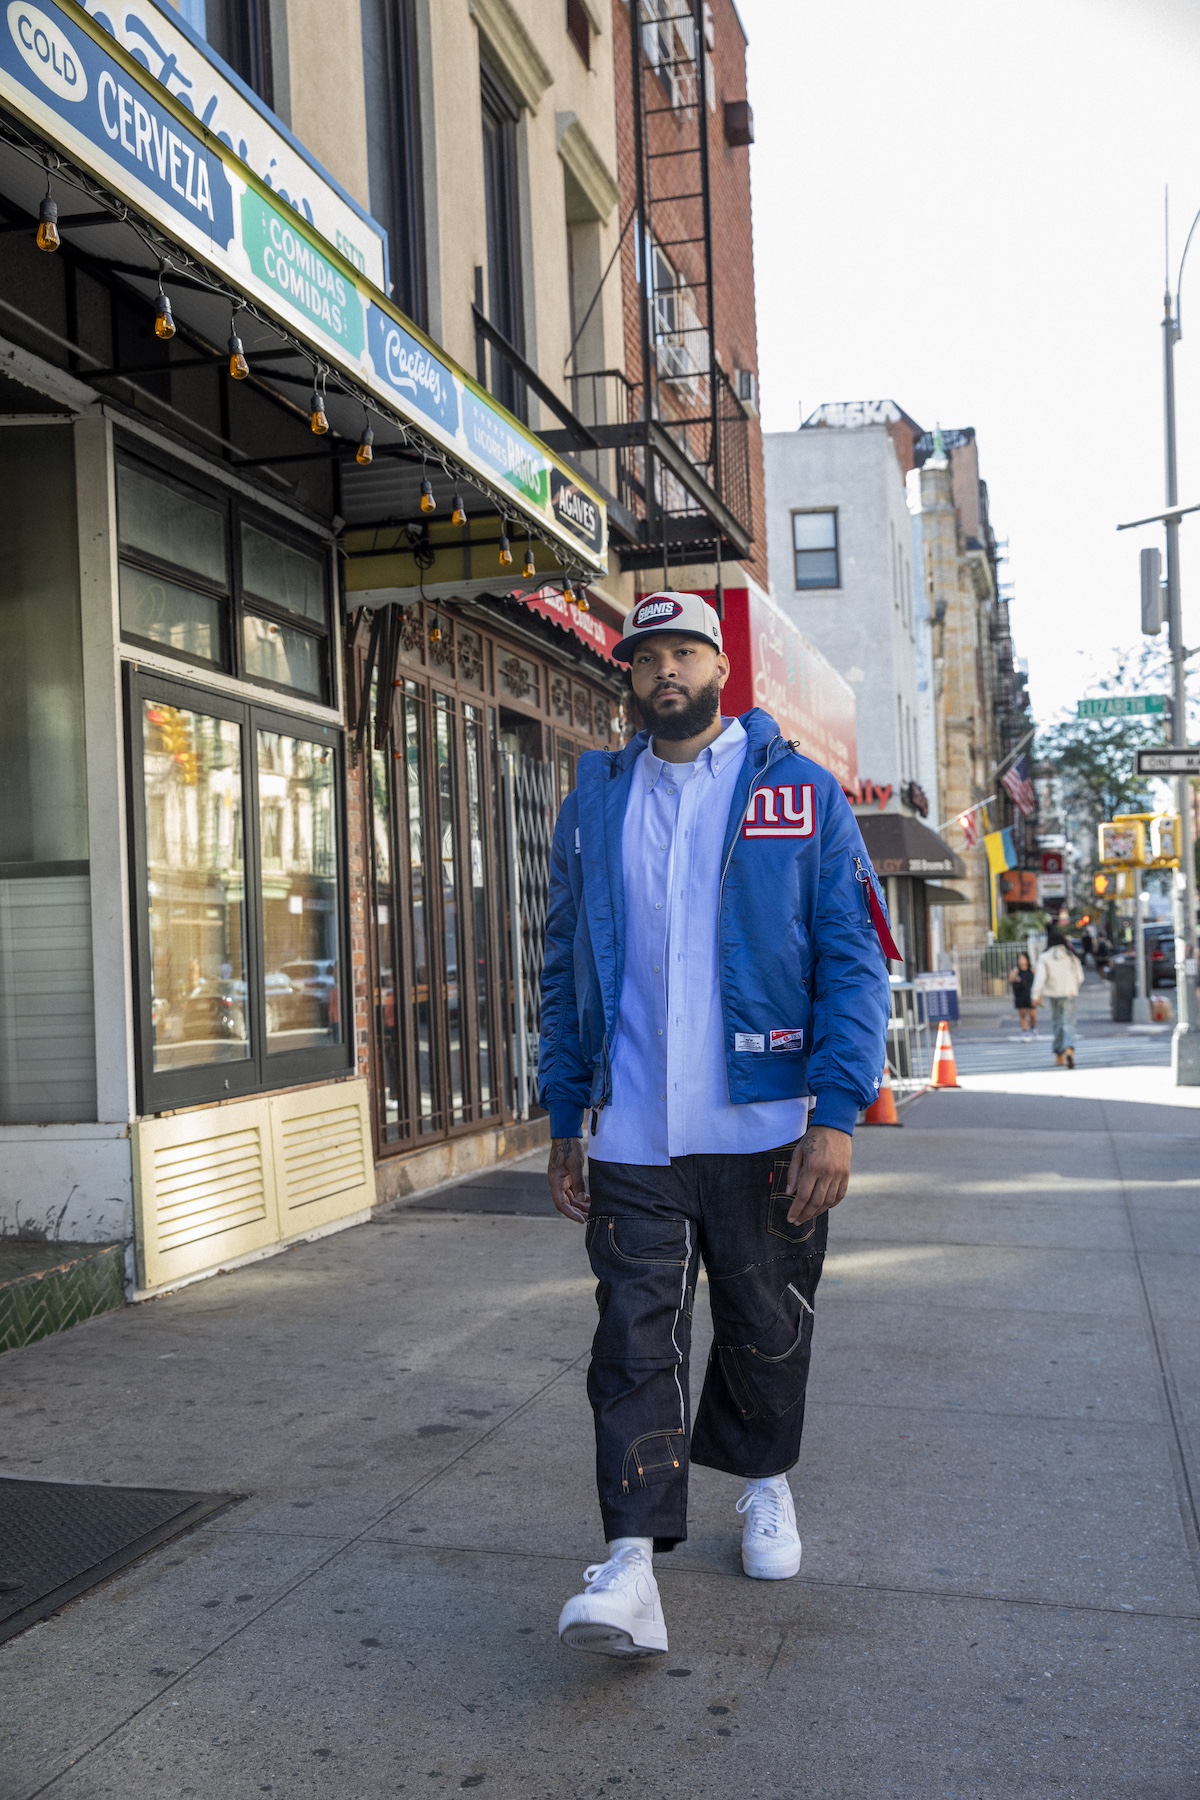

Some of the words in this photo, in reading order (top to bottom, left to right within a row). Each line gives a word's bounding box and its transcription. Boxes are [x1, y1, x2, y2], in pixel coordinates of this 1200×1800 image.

[17, 14, 77, 86] COLD
[98, 70, 214, 222] CERVEZA
[263, 246, 342, 335] COMIDAS
[269, 218, 347, 307] COMIDAS
[473, 423, 507, 467] LICORES
[506, 435, 541, 495] RAROS
[558, 485, 595, 532] AGAVES
[638, 602, 674, 620] GIANTS
[1080, 698, 1146, 717] ELIZABETH
[1148, 757, 1172, 769] ONE
